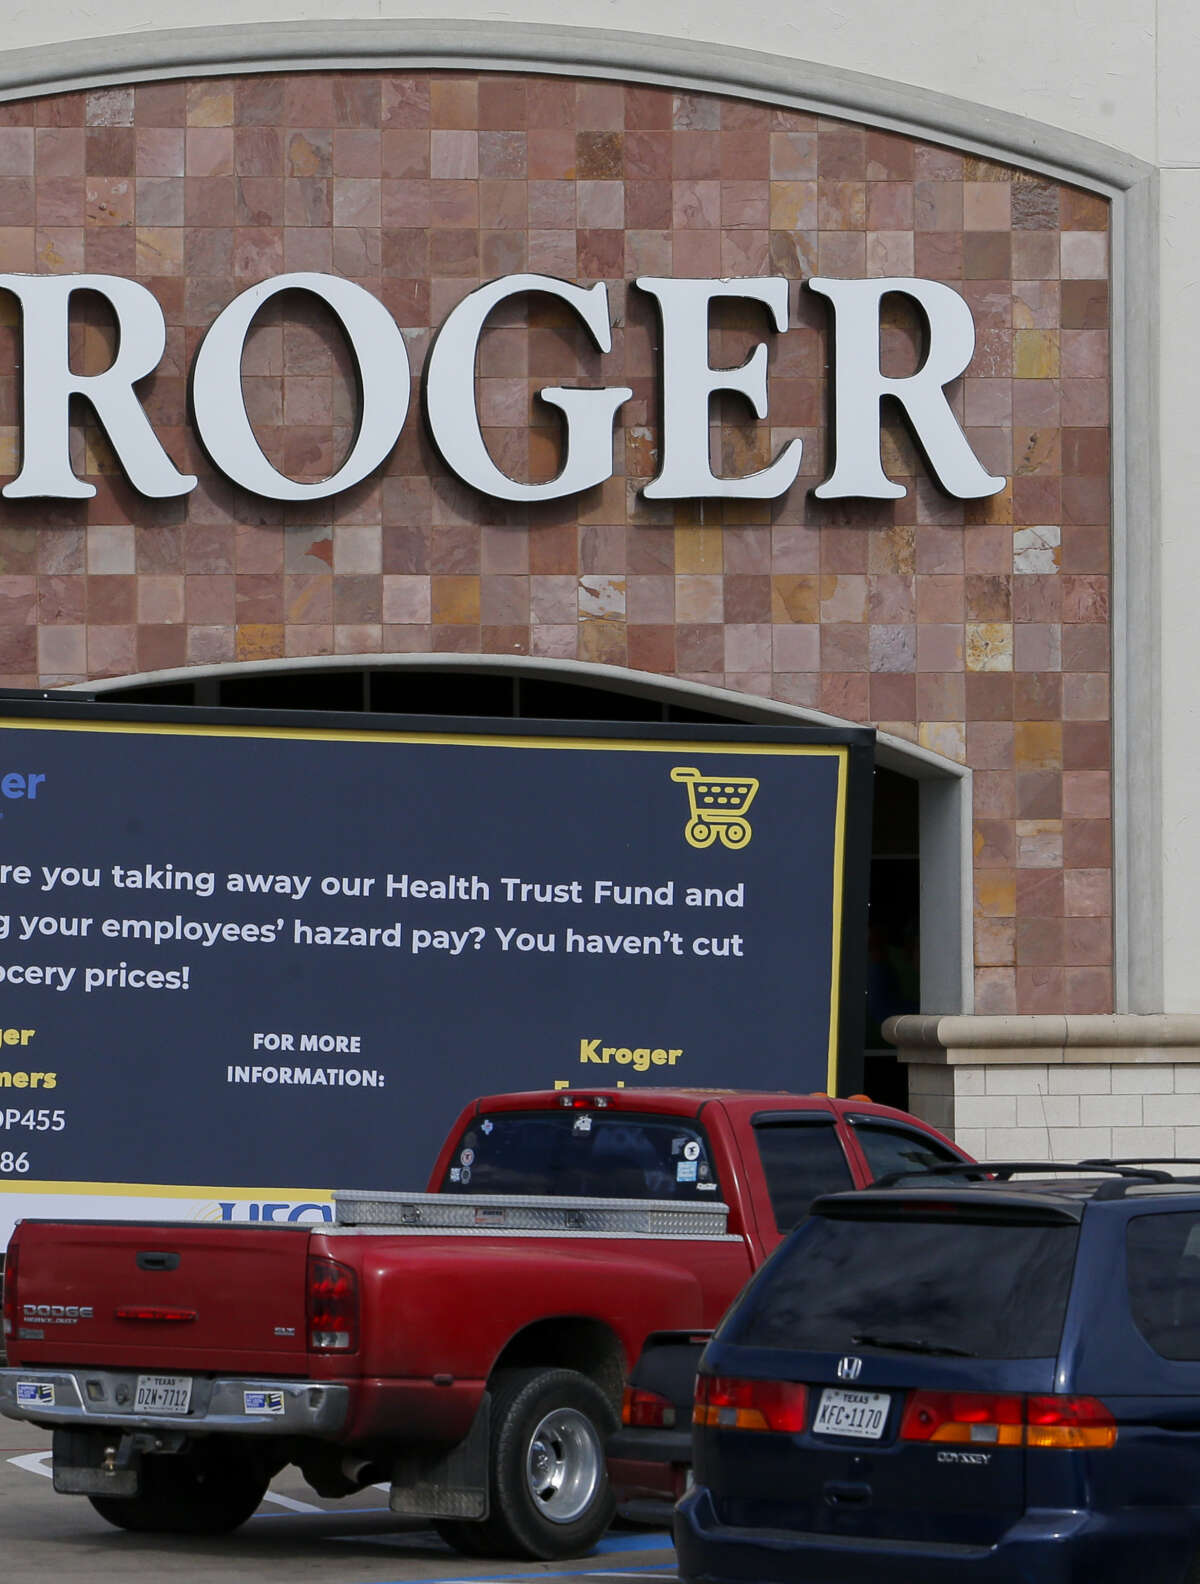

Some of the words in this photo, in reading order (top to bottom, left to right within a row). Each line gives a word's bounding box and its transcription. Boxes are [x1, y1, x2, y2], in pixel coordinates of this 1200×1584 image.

[41, 867, 100, 891] you
[112, 864, 214, 896] taking
[227, 874, 311, 899] away
[321, 877, 375, 896] our
[387, 874, 489, 900] Health
[501, 878, 582, 903] Trust
[595, 881, 673, 905] Fund
[686, 883, 744, 907] and
[19, 916, 93, 940] your
[295, 920, 401, 947] hazard
[413, 927, 485, 955] pay?
[495, 928, 555, 951] You
[693, 935, 743, 956] cut
[85, 962, 189, 992] prices!
[253, 1033, 295, 1051] FOR
[300, 1034, 361, 1053] MORE
[580, 1040, 683, 1071] Kroger
[227, 1065, 385, 1087] INFORMATION:
[23, 1305, 93, 1318] DODGE
[155, 1378, 176, 1386] TEXAS
[843, 1393, 869, 1404] TEXAS
[937, 1451, 991, 1465] ODYSSEY
